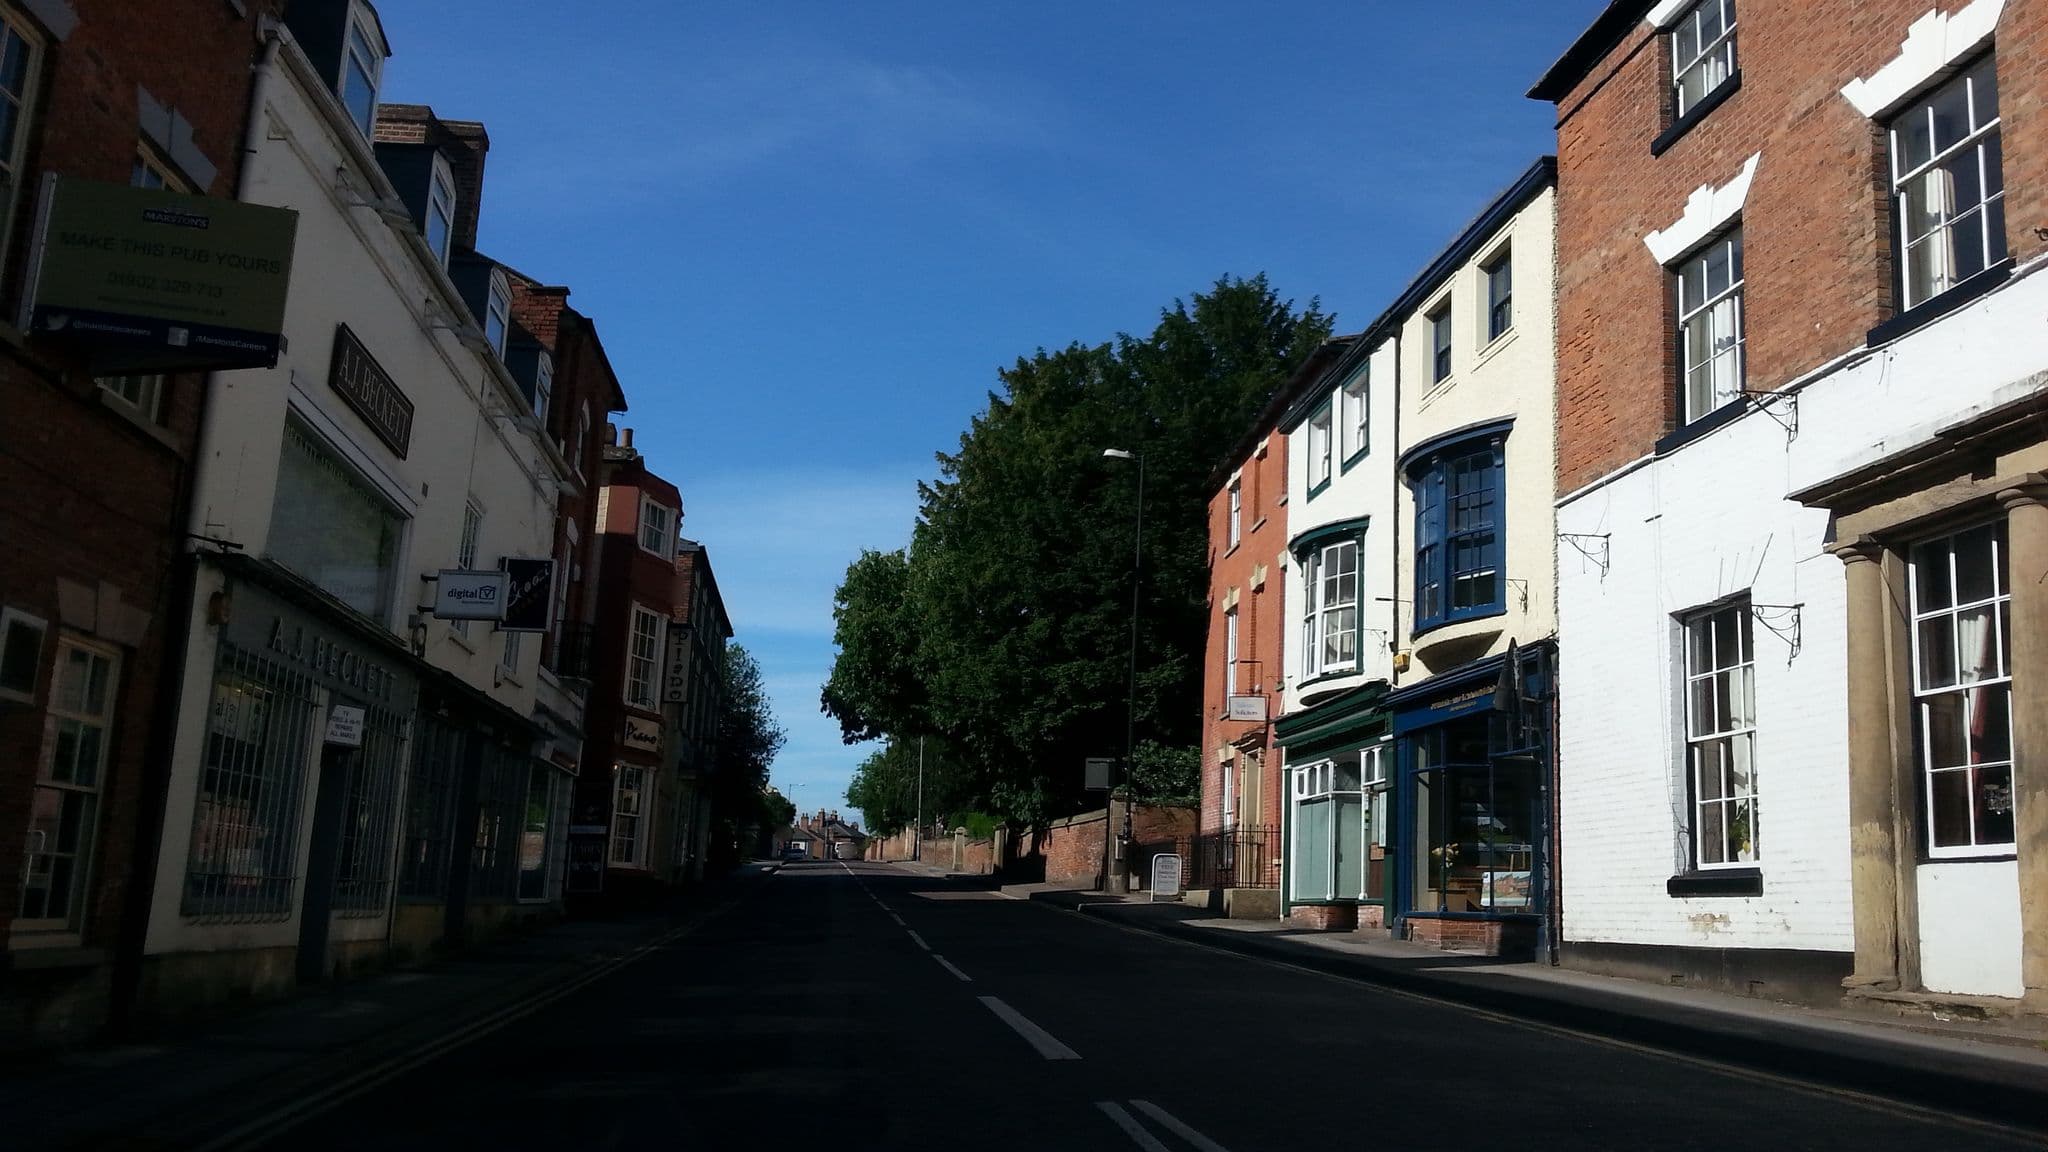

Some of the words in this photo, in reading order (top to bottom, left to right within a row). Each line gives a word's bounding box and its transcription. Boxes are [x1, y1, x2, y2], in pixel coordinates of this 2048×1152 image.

[61, 232, 115, 251] MAKE
[124, 239, 164, 256] THIS
[171, 246, 209, 263] PUB
[216, 252, 280, 274] YOURS
[361, 367, 408, 442] BECKETT
[447, 588, 478, 600] digital
[316, 636, 398, 705] BECKETT
